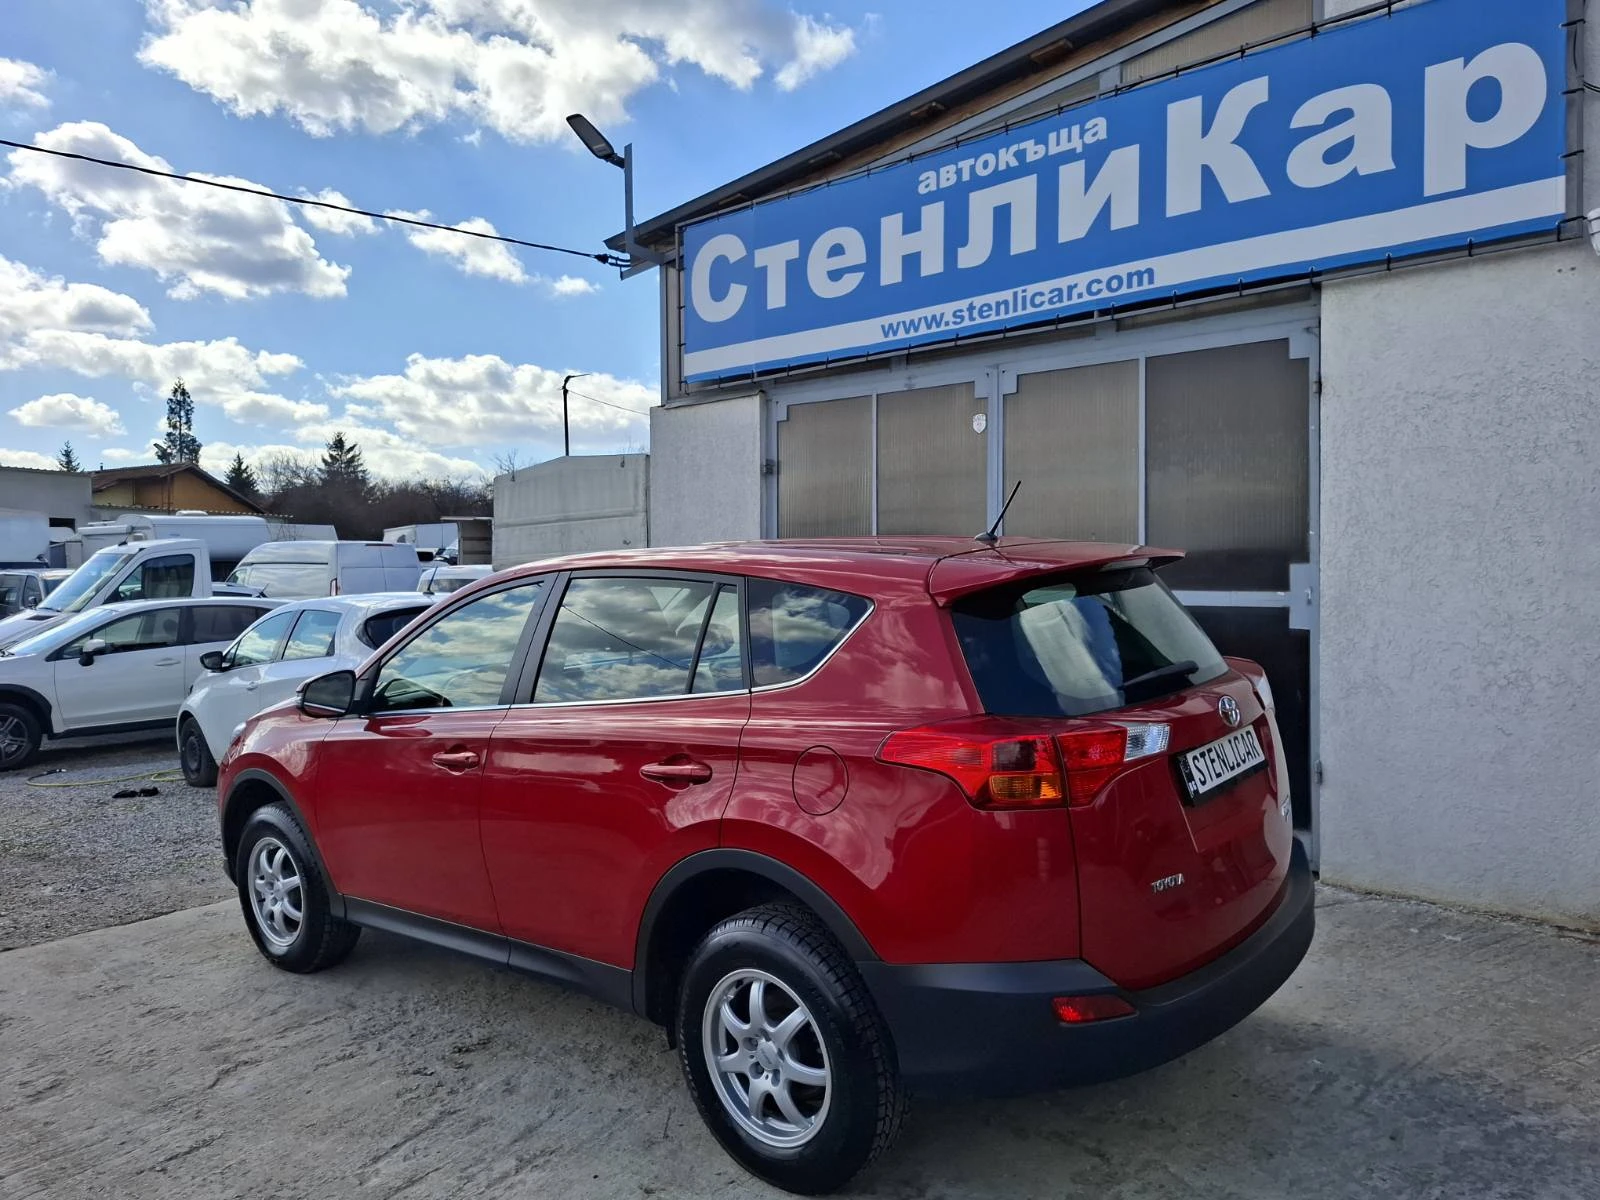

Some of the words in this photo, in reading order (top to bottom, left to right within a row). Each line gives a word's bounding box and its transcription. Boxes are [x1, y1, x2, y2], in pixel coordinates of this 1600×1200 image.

[690, 42, 1549, 323] СтенлиКар
[917, 116, 1107, 194] автокъща
[881, 267, 1155, 338] www.stenlicar.com
[1192, 730, 1260, 786] STENLICAR
[1151, 873, 1185, 893] TOYOTA
